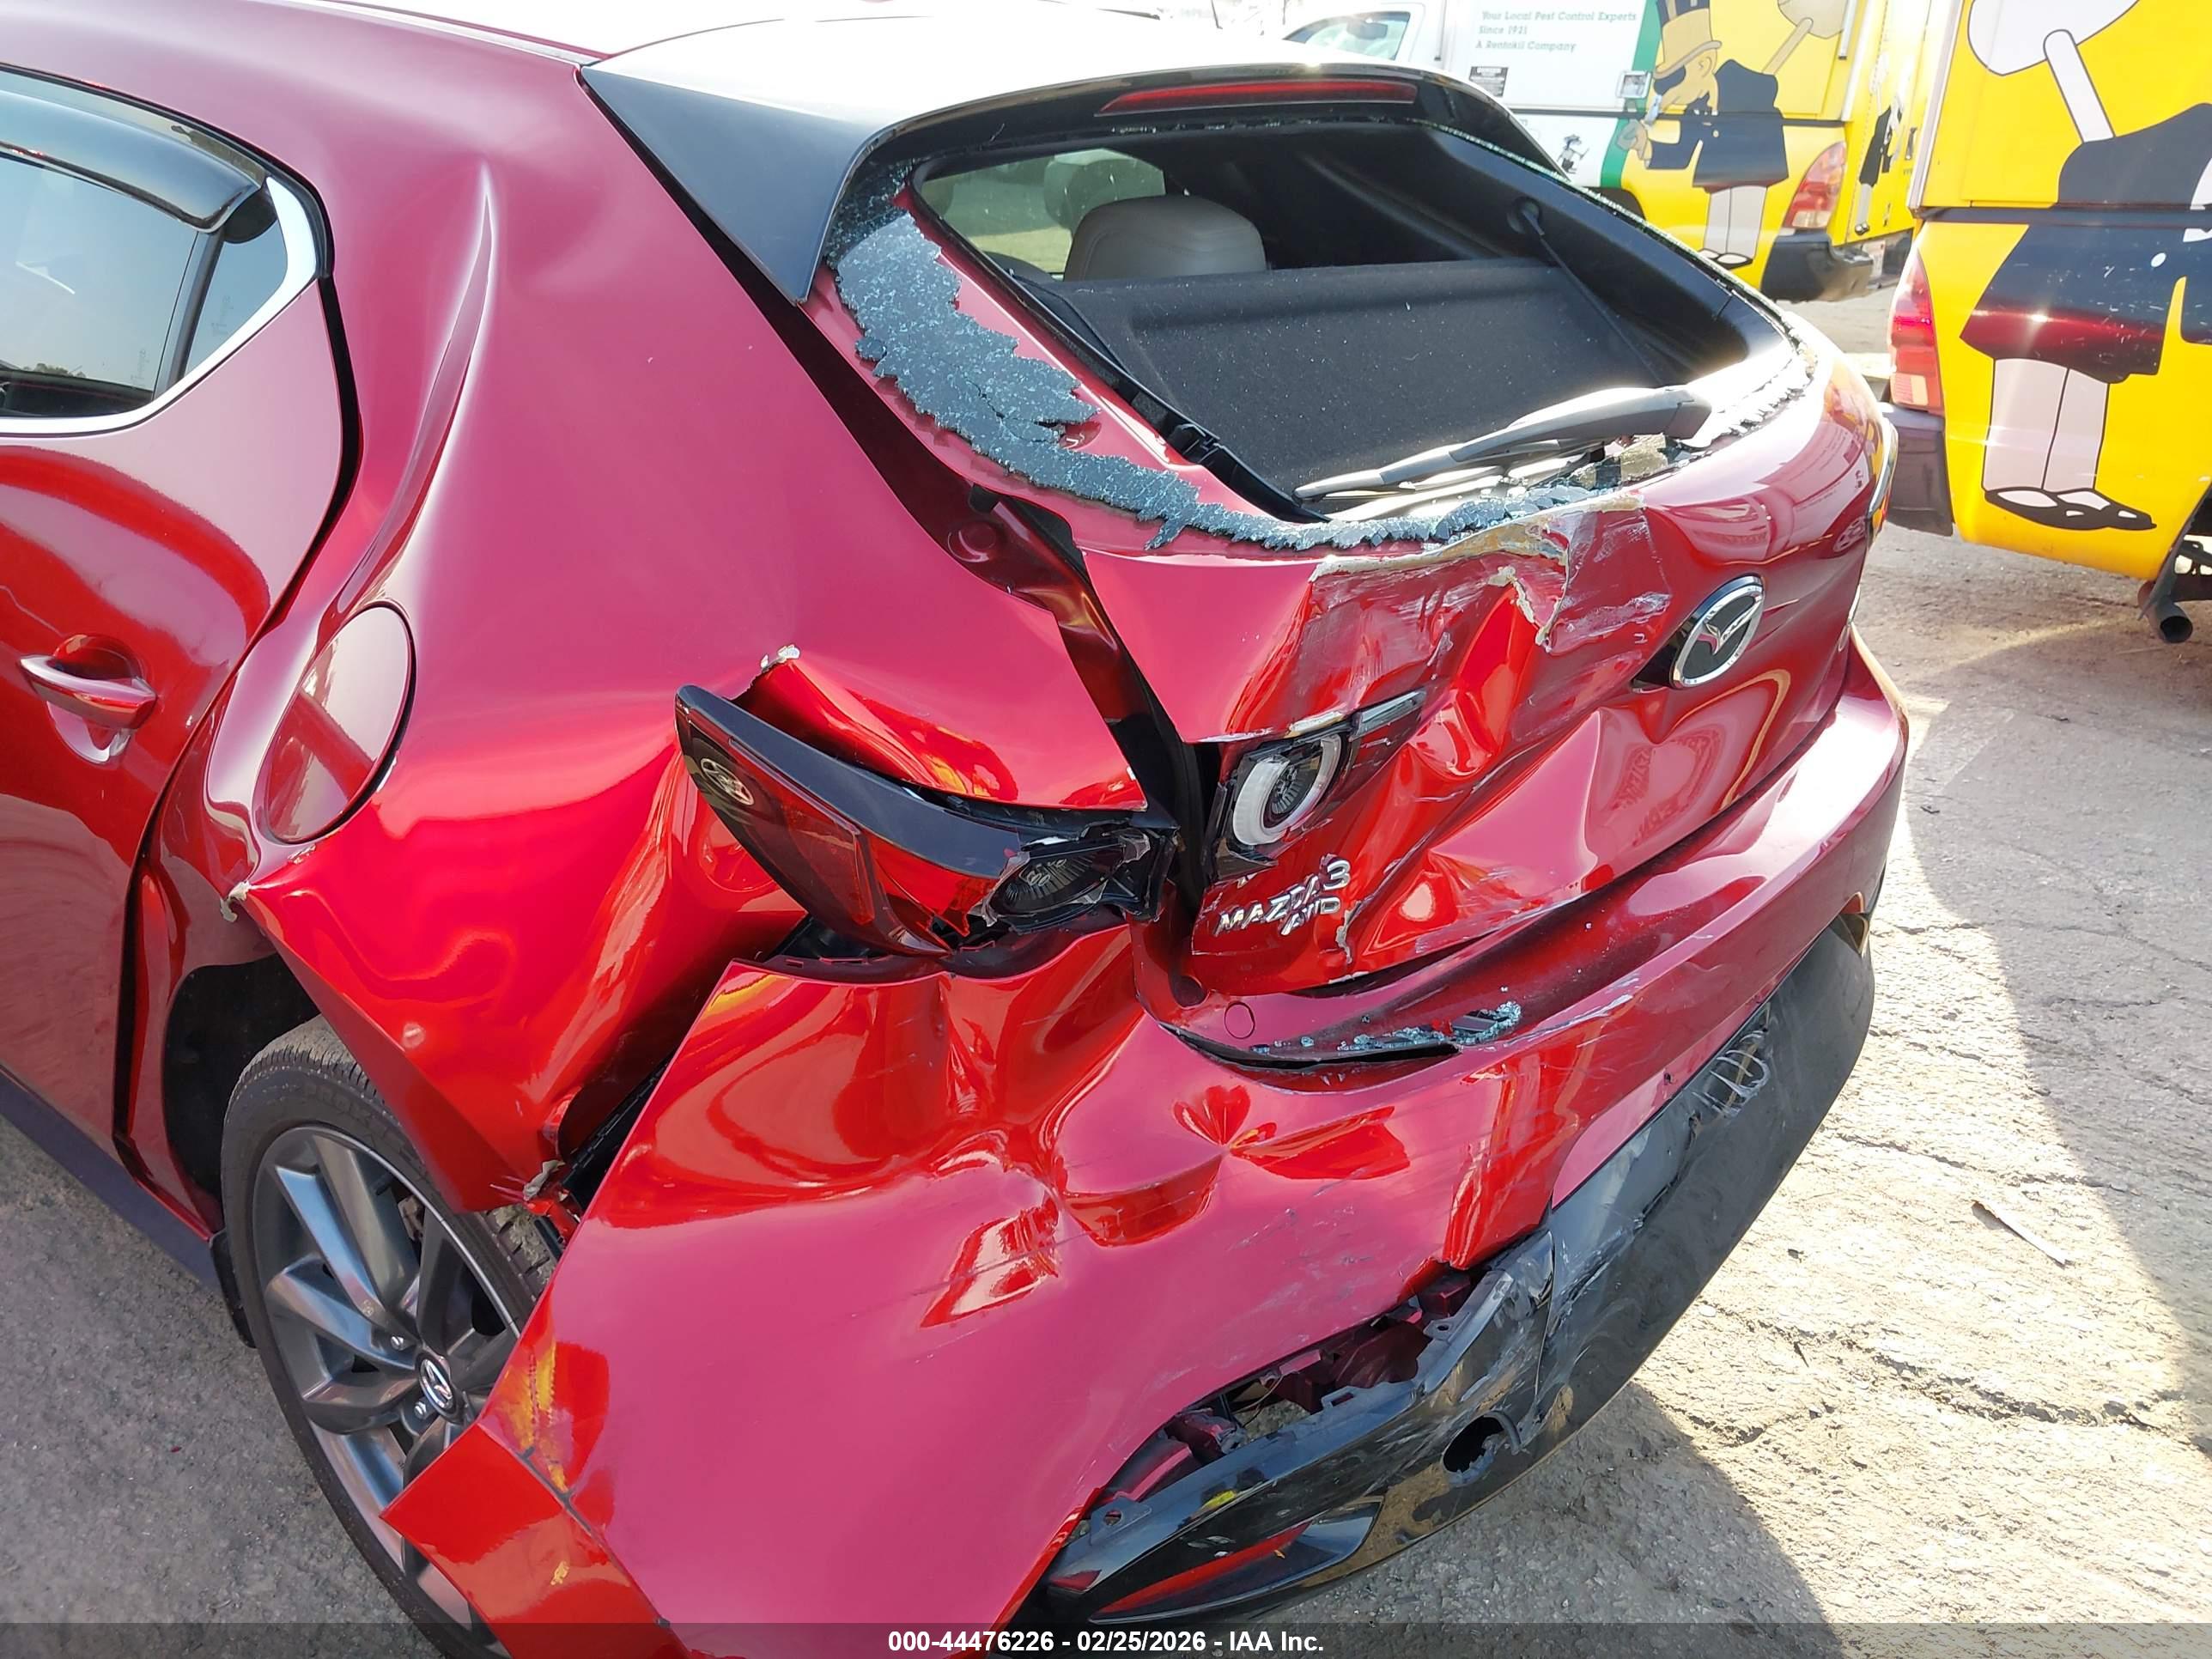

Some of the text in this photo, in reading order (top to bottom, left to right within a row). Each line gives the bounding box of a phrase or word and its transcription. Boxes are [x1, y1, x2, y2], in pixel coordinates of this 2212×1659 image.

[1481, 10, 1637, 23] Your Local Pest Control Experts
[1478, 25, 1504, 35] Since
[1475, 40, 1577, 53] A Rentokil Company
